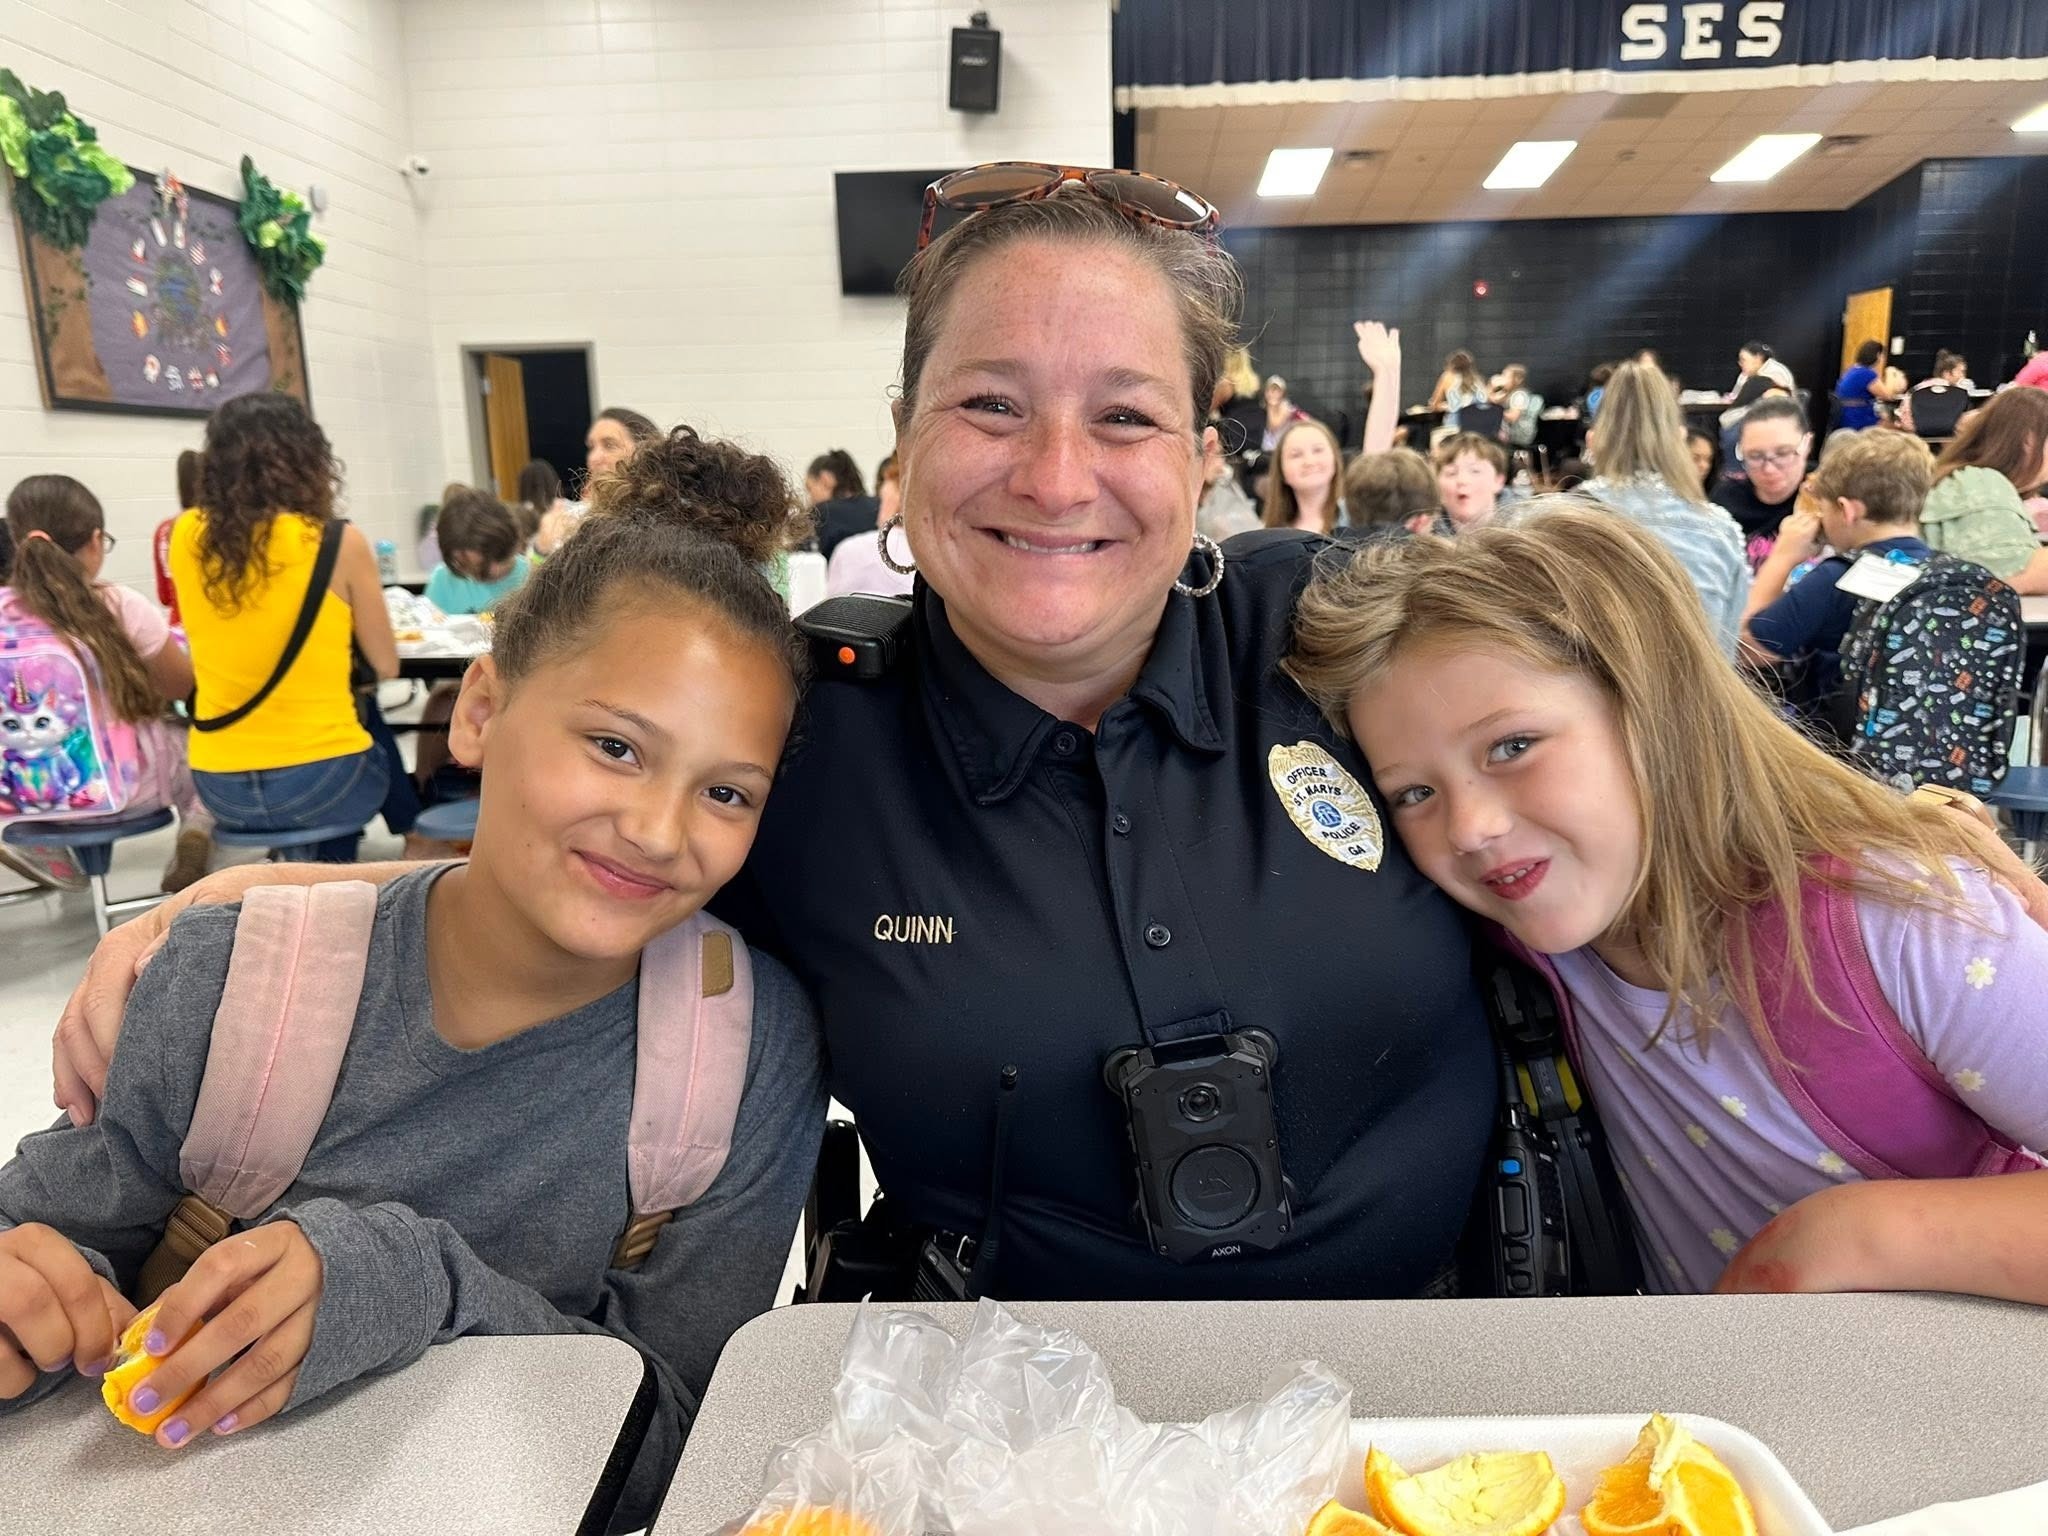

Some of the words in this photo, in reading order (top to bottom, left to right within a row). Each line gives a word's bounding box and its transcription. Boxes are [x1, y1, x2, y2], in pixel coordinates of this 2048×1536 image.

[1620, 2, 1785, 62] SES
[1287, 767, 1327, 785] OFFICER
[1294, 793, 1305, 806] ST.
[1305, 784, 1341, 796] MARYS
[1322, 822, 1361, 839] POLICE
[1348, 844, 1366, 856] GA
[874, 914, 954, 944] QUINN
[1212, 1245, 1241, 1258] AXON
